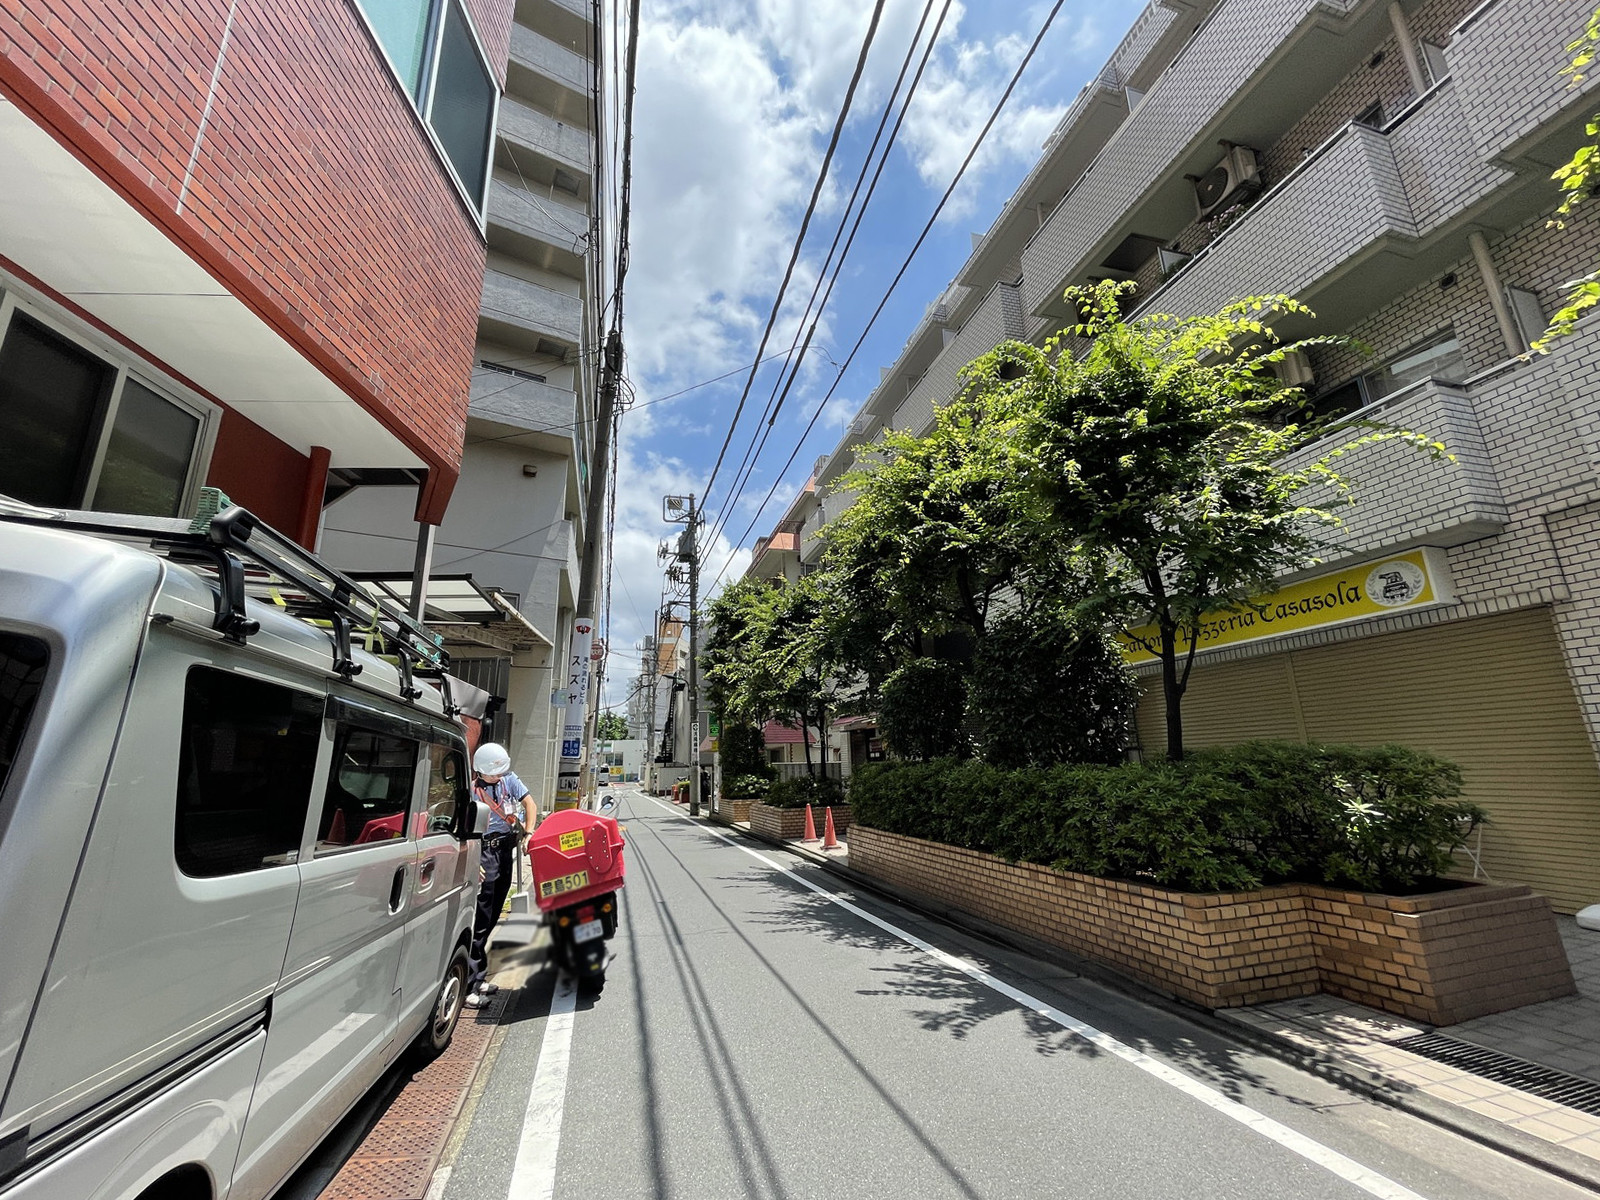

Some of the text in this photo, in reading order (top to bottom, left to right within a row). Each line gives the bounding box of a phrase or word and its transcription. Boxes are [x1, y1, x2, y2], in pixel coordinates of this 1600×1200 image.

[1259, 580, 1362, 623] Casasola
[568, 655, 581, 704] スズヤ
